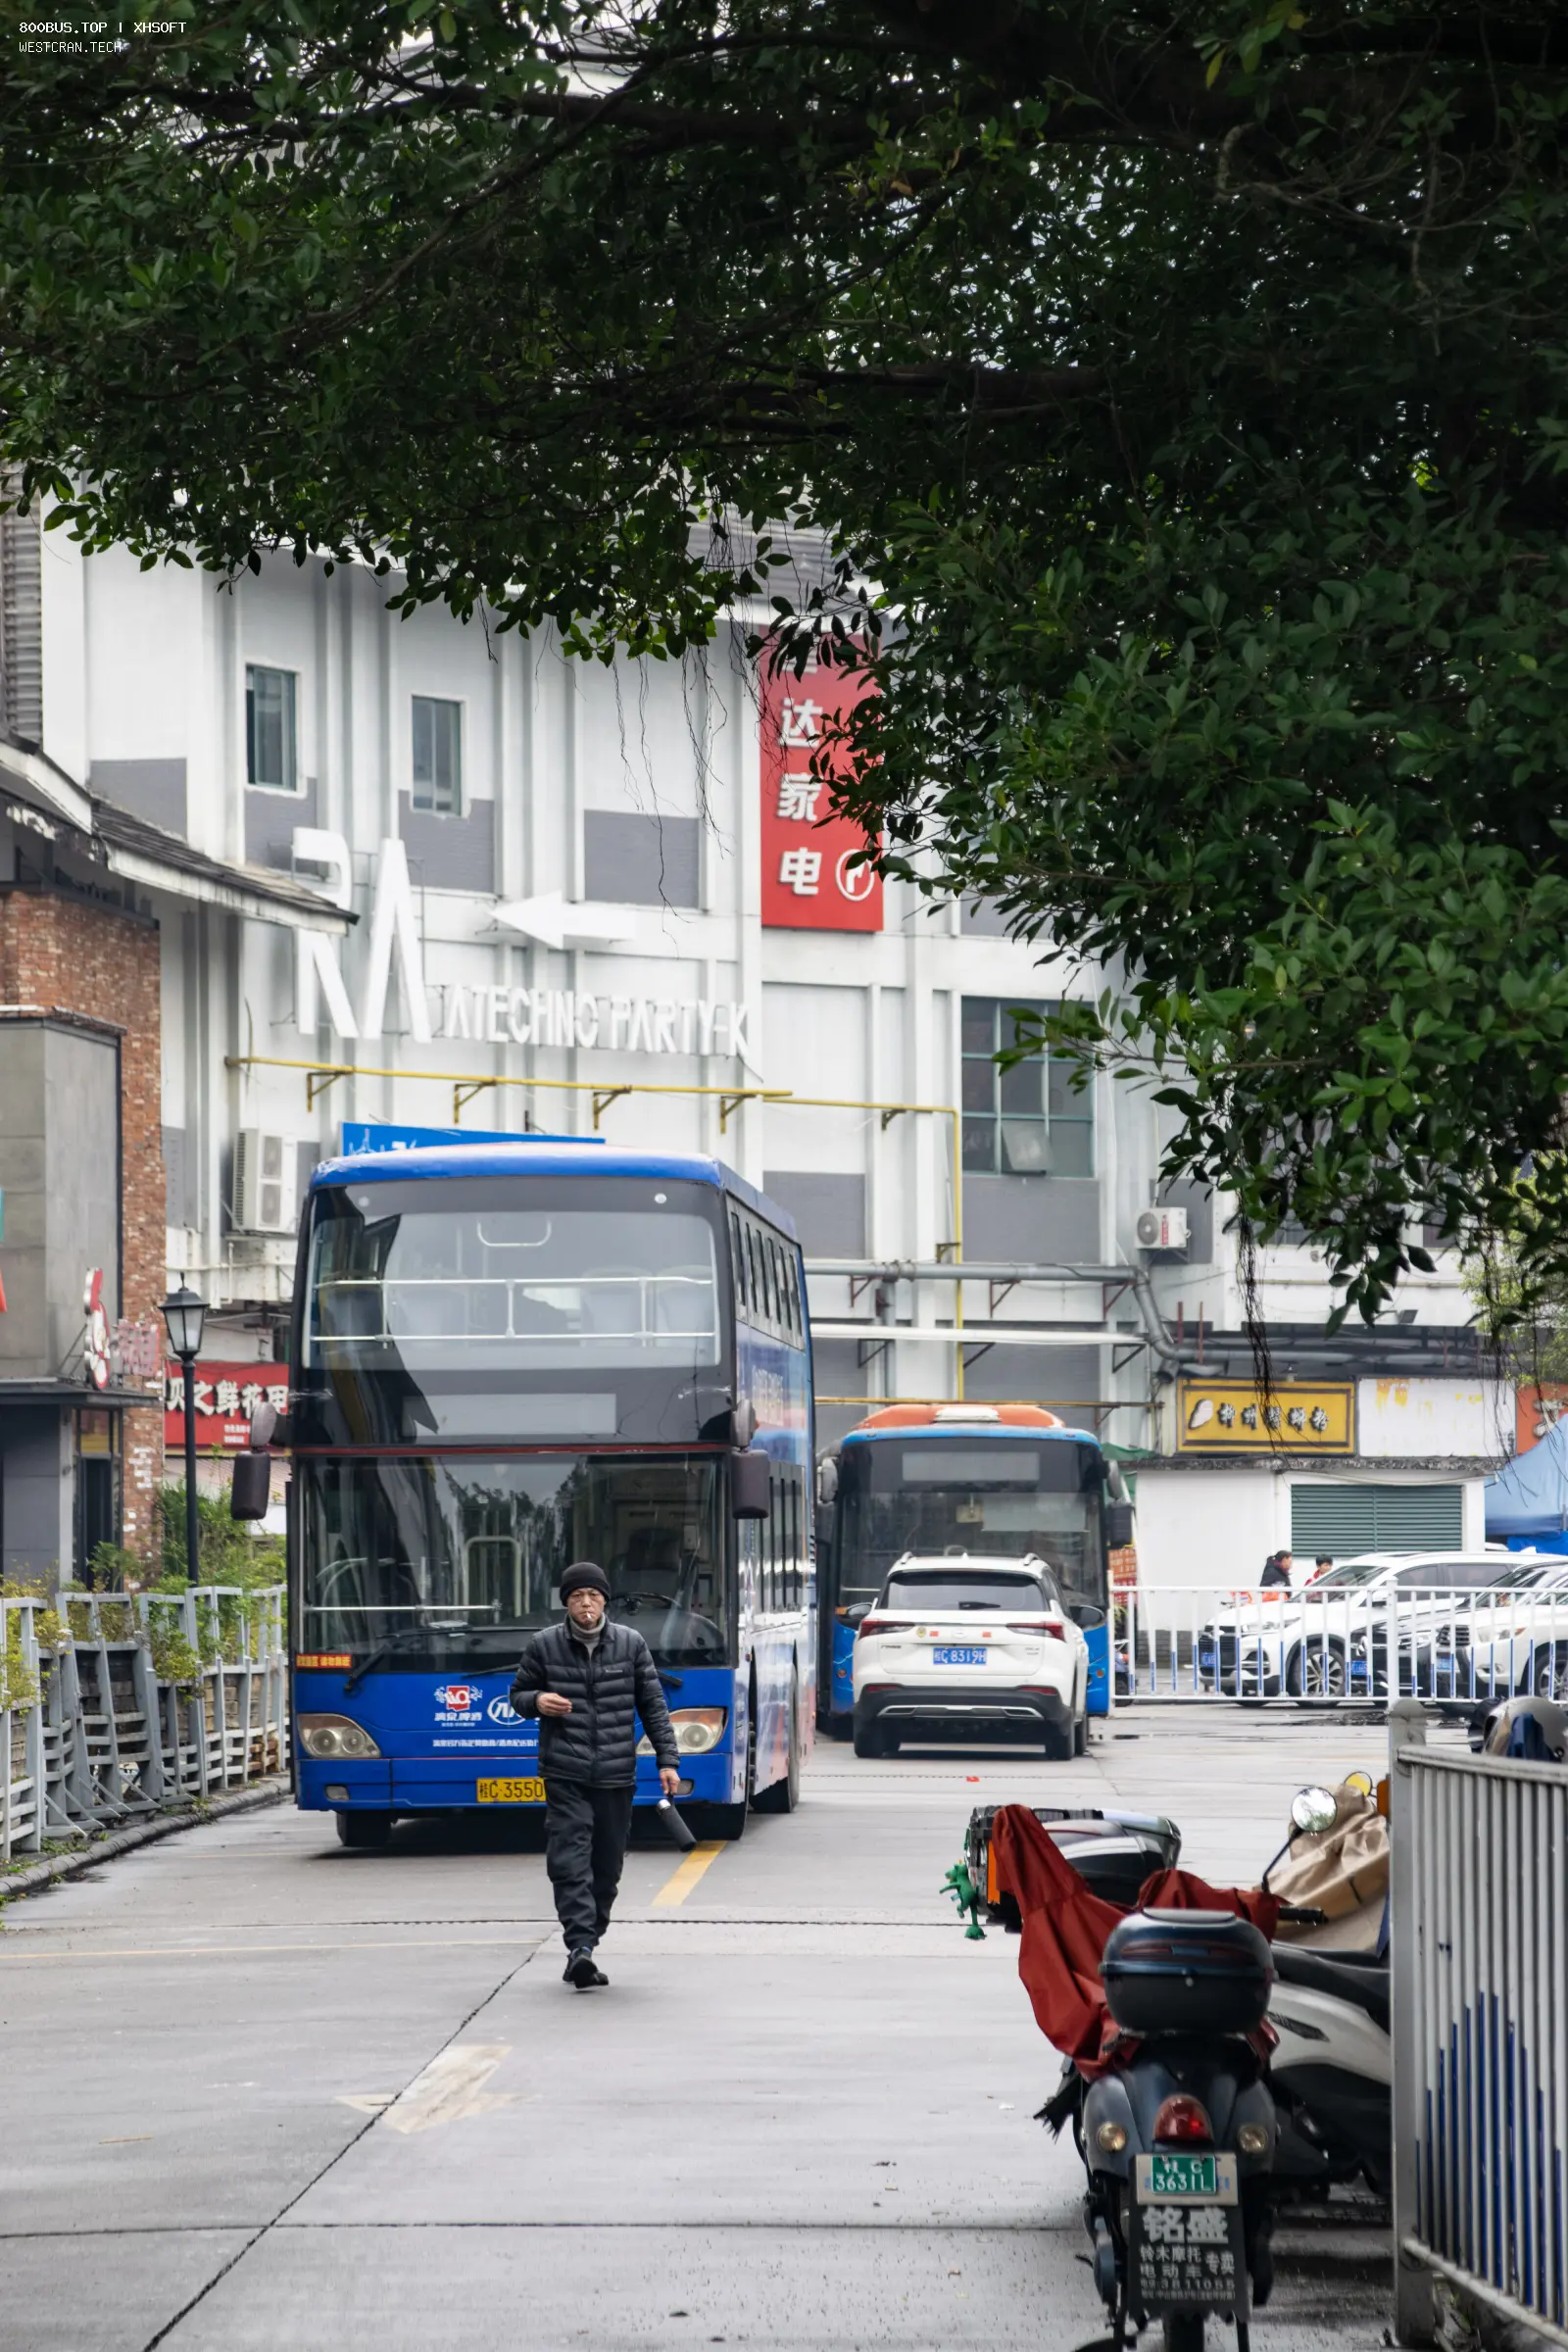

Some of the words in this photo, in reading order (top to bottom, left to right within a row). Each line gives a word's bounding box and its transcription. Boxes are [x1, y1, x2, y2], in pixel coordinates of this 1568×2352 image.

[478, 1782, 544, 1798] 桂C·3550
[1142, 2206, 1229, 2244] 铭盛
[1140, 2244, 1201, 2263] 铃木摩托
